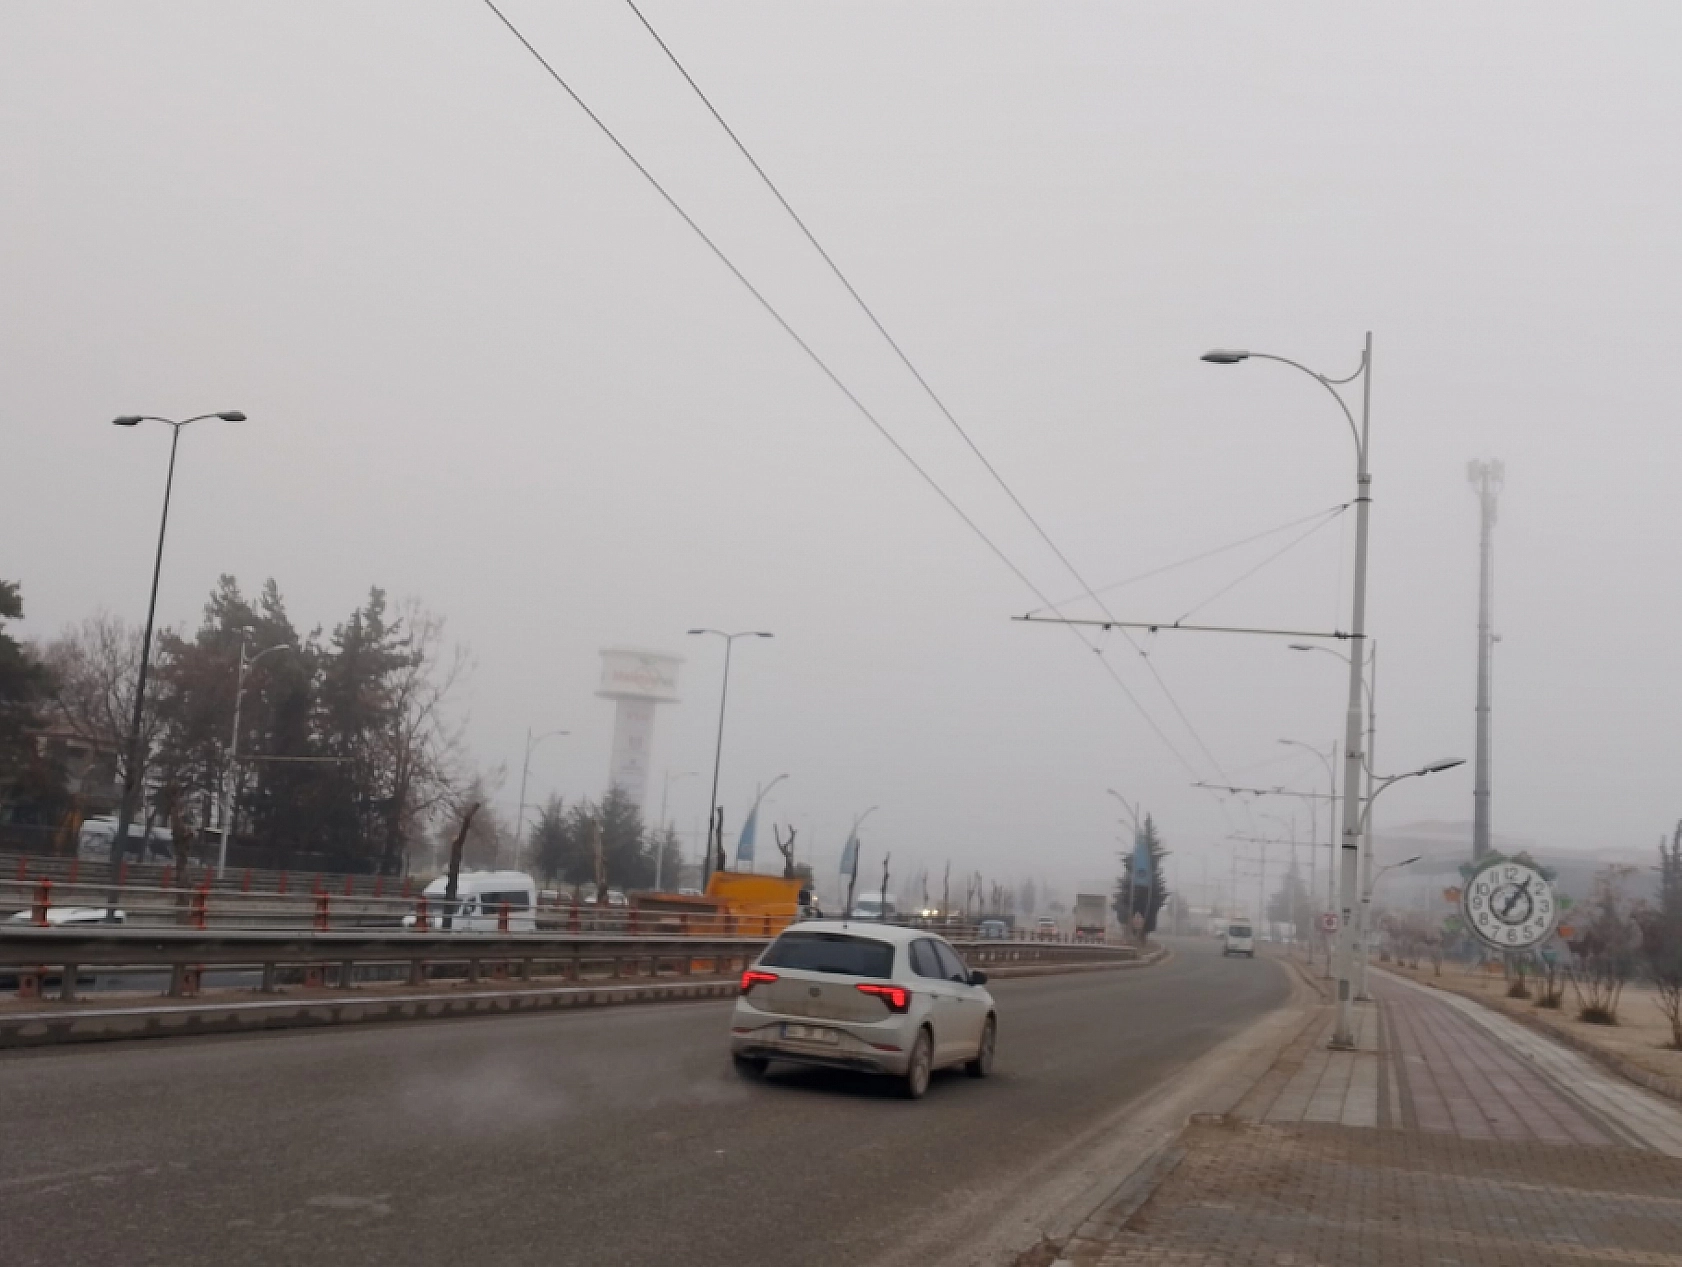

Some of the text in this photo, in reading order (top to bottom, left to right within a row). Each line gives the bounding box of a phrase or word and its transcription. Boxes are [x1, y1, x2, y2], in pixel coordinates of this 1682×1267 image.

[1490, 871, 1499, 883] 11
[1504, 867, 1518, 880] 12
[1476, 883, 1489, 896] 10
[1535, 883, 1545, 896] 2
[1473, 896, 1482, 910] 9
[1540, 899, 1549, 912] 3
[1480, 912, 1488, 925] 8
[1534, 916, 1544, 927] 4
[1492, 925, 1501, 938] 7
[1507, 929, 1517, 942] 6
[1523, 925, 1532, 938] 5
